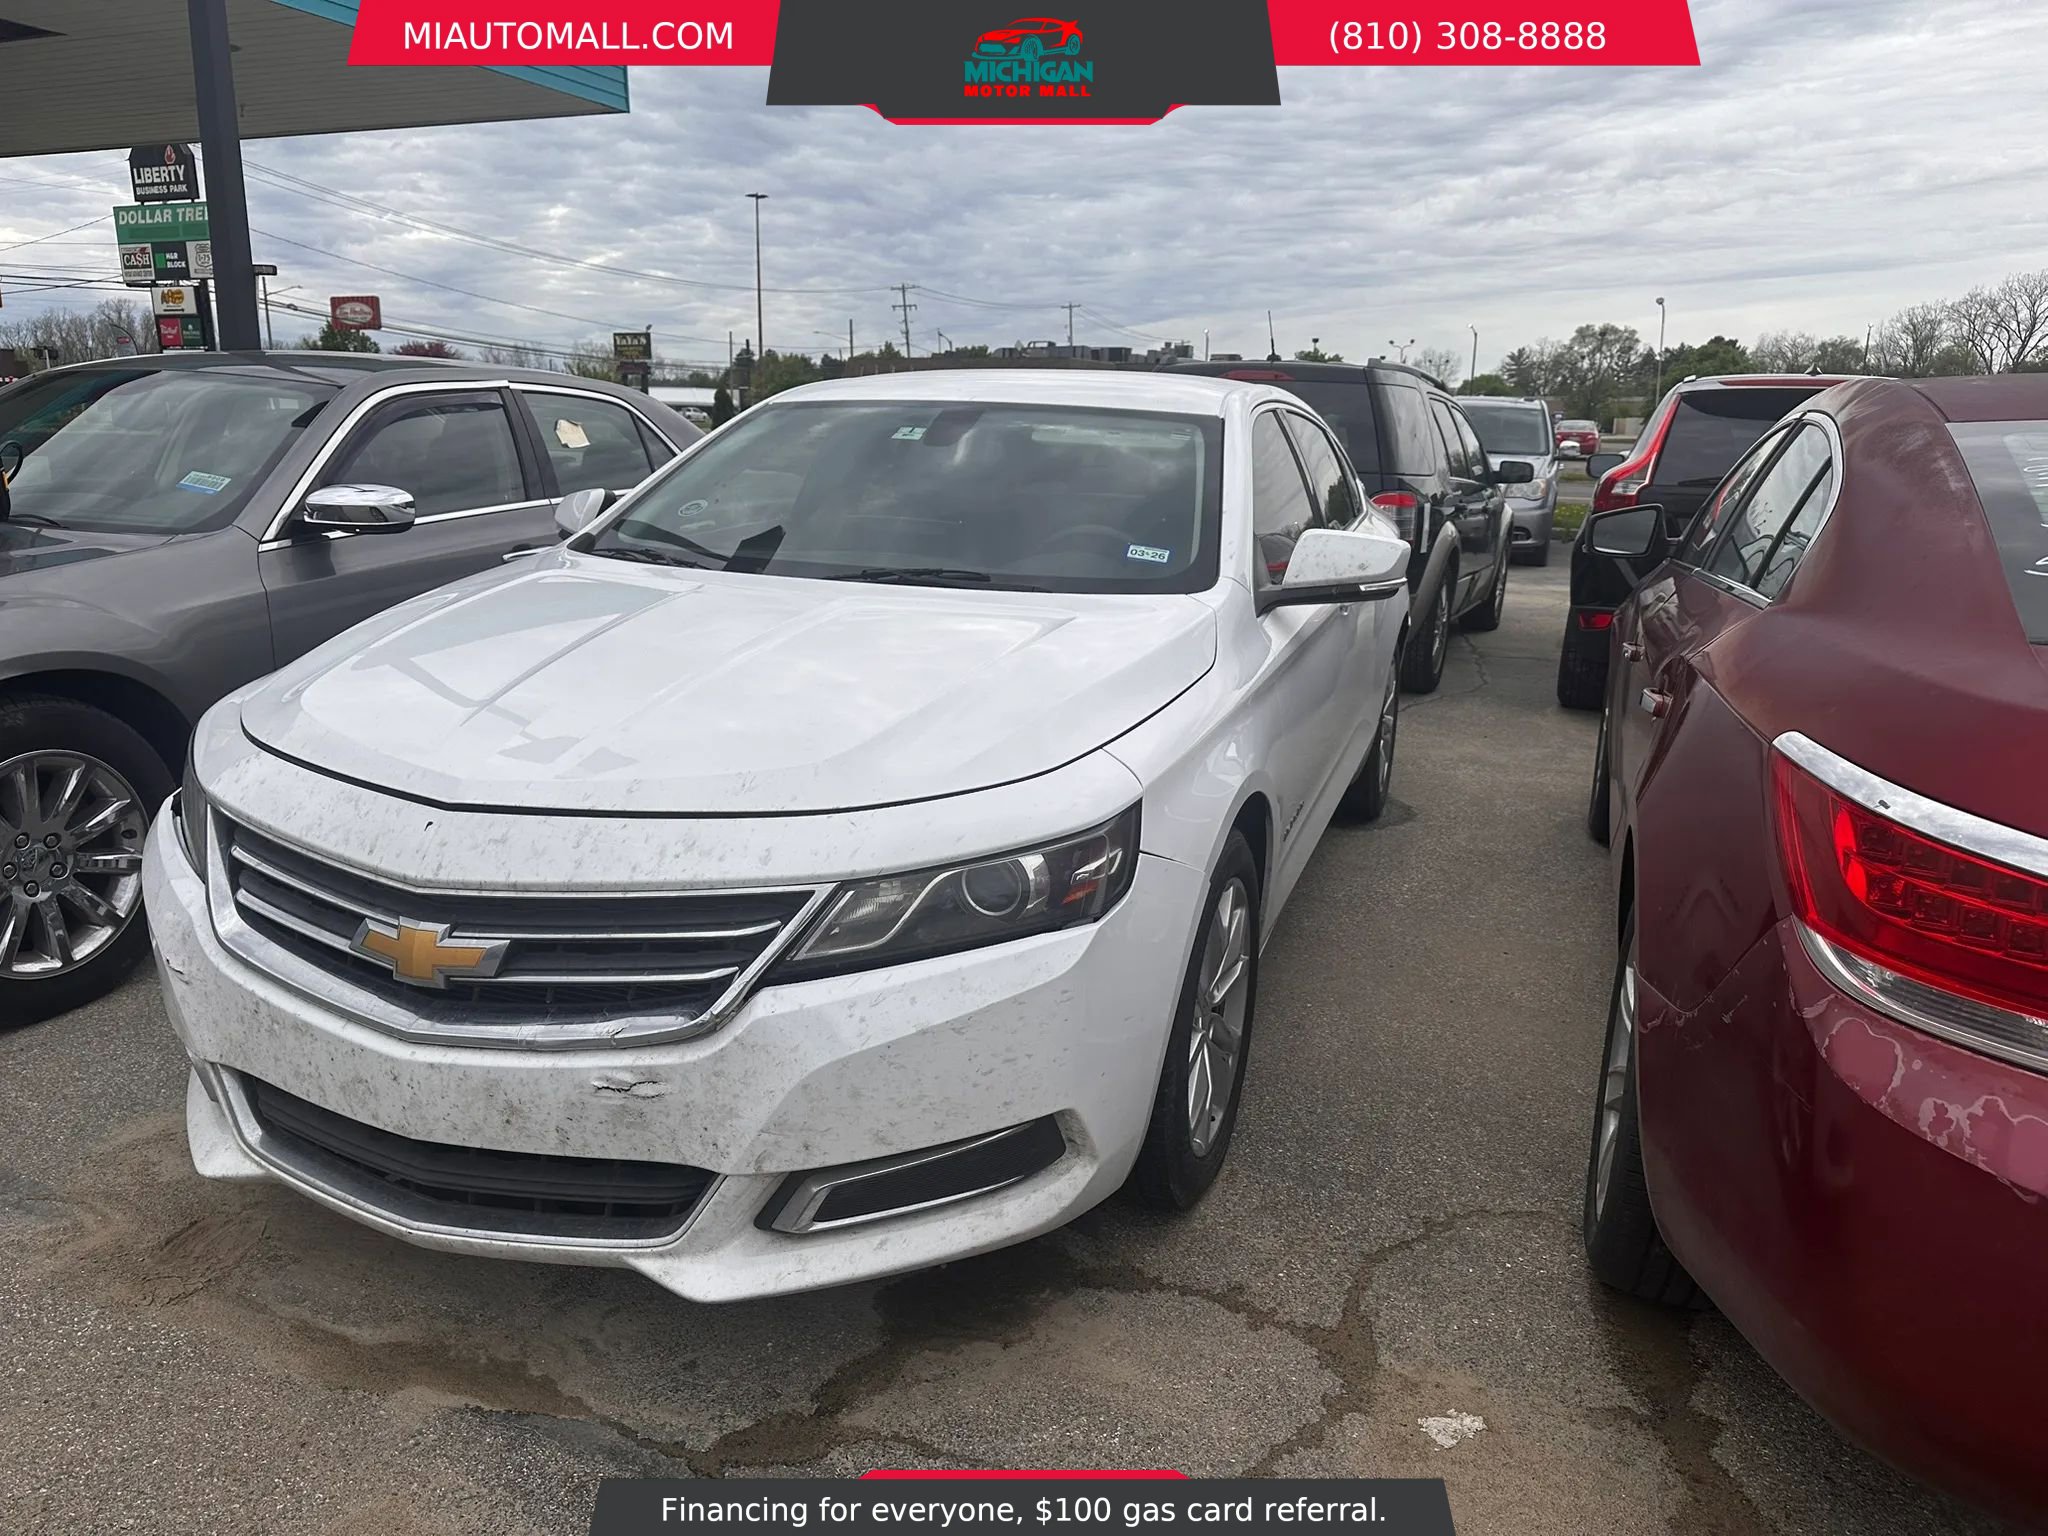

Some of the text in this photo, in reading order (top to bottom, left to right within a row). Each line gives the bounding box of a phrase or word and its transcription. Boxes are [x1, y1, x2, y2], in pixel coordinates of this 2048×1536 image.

[133, 165, 185, 184] LIBERTY
[136, 184, 188, 195] BUSINESS PARK
[118, 209, 172, 225] DOLLAR
[166, 261, 186, 269] BLOCK
